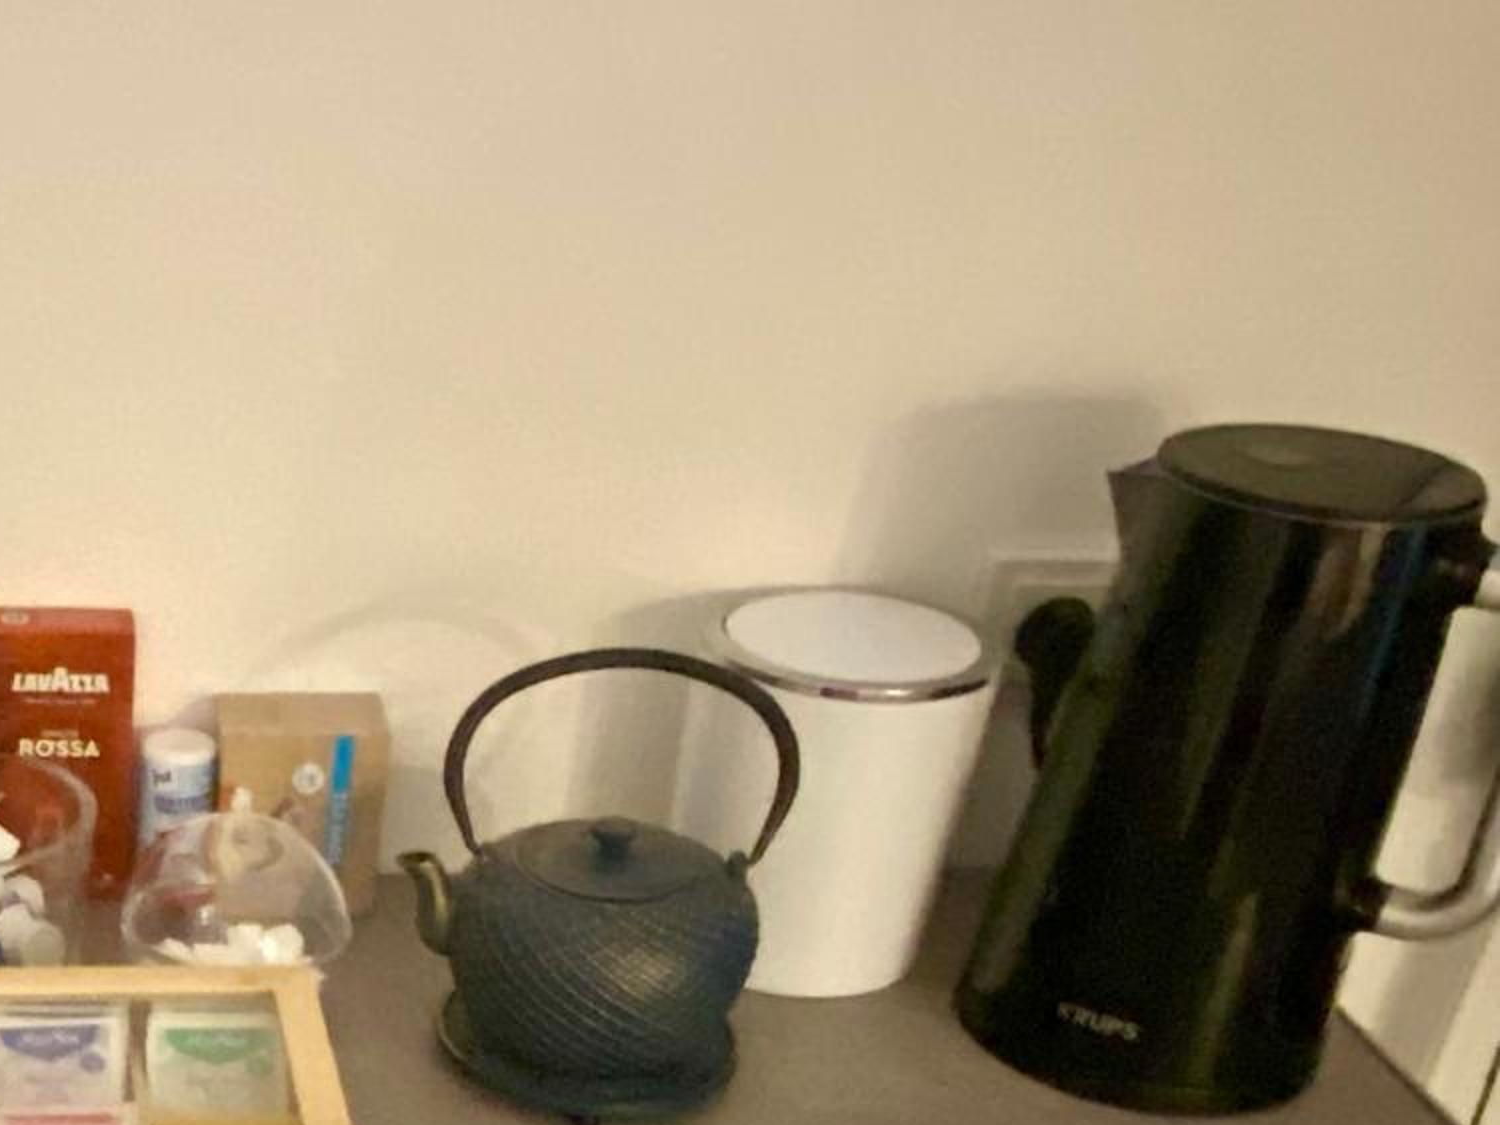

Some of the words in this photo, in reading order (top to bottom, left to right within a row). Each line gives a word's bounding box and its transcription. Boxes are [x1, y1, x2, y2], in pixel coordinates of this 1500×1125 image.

[11, 667, 110, 693] LAVAZZA
[19, 738, 100, 758] ROSSA
[1057, 1001, 1140, 1041] KRUPS
